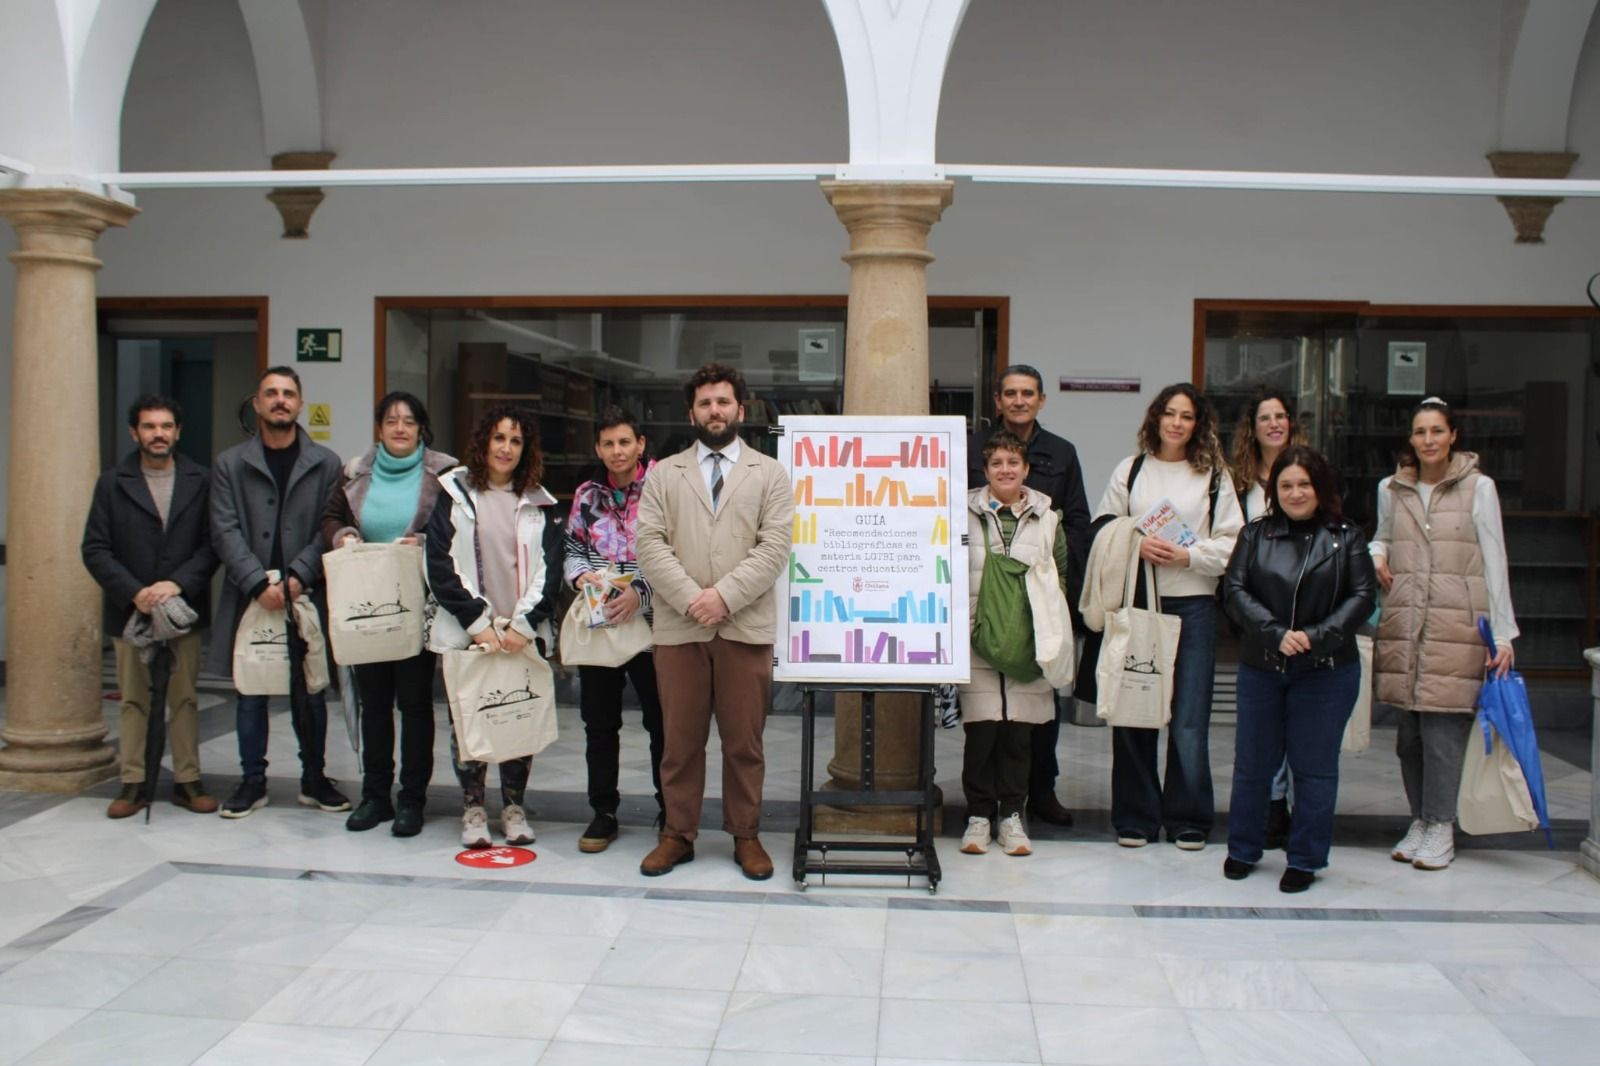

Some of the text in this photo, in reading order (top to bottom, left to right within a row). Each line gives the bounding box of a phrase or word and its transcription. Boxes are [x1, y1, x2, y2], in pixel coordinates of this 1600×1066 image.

[855, 513, 886, 526] GUÍA
[823, 541, 903, 551] bibliográficas
[820, 552, 921, 564] materia LGTBI para
[817, 564, 858, 573] centros
